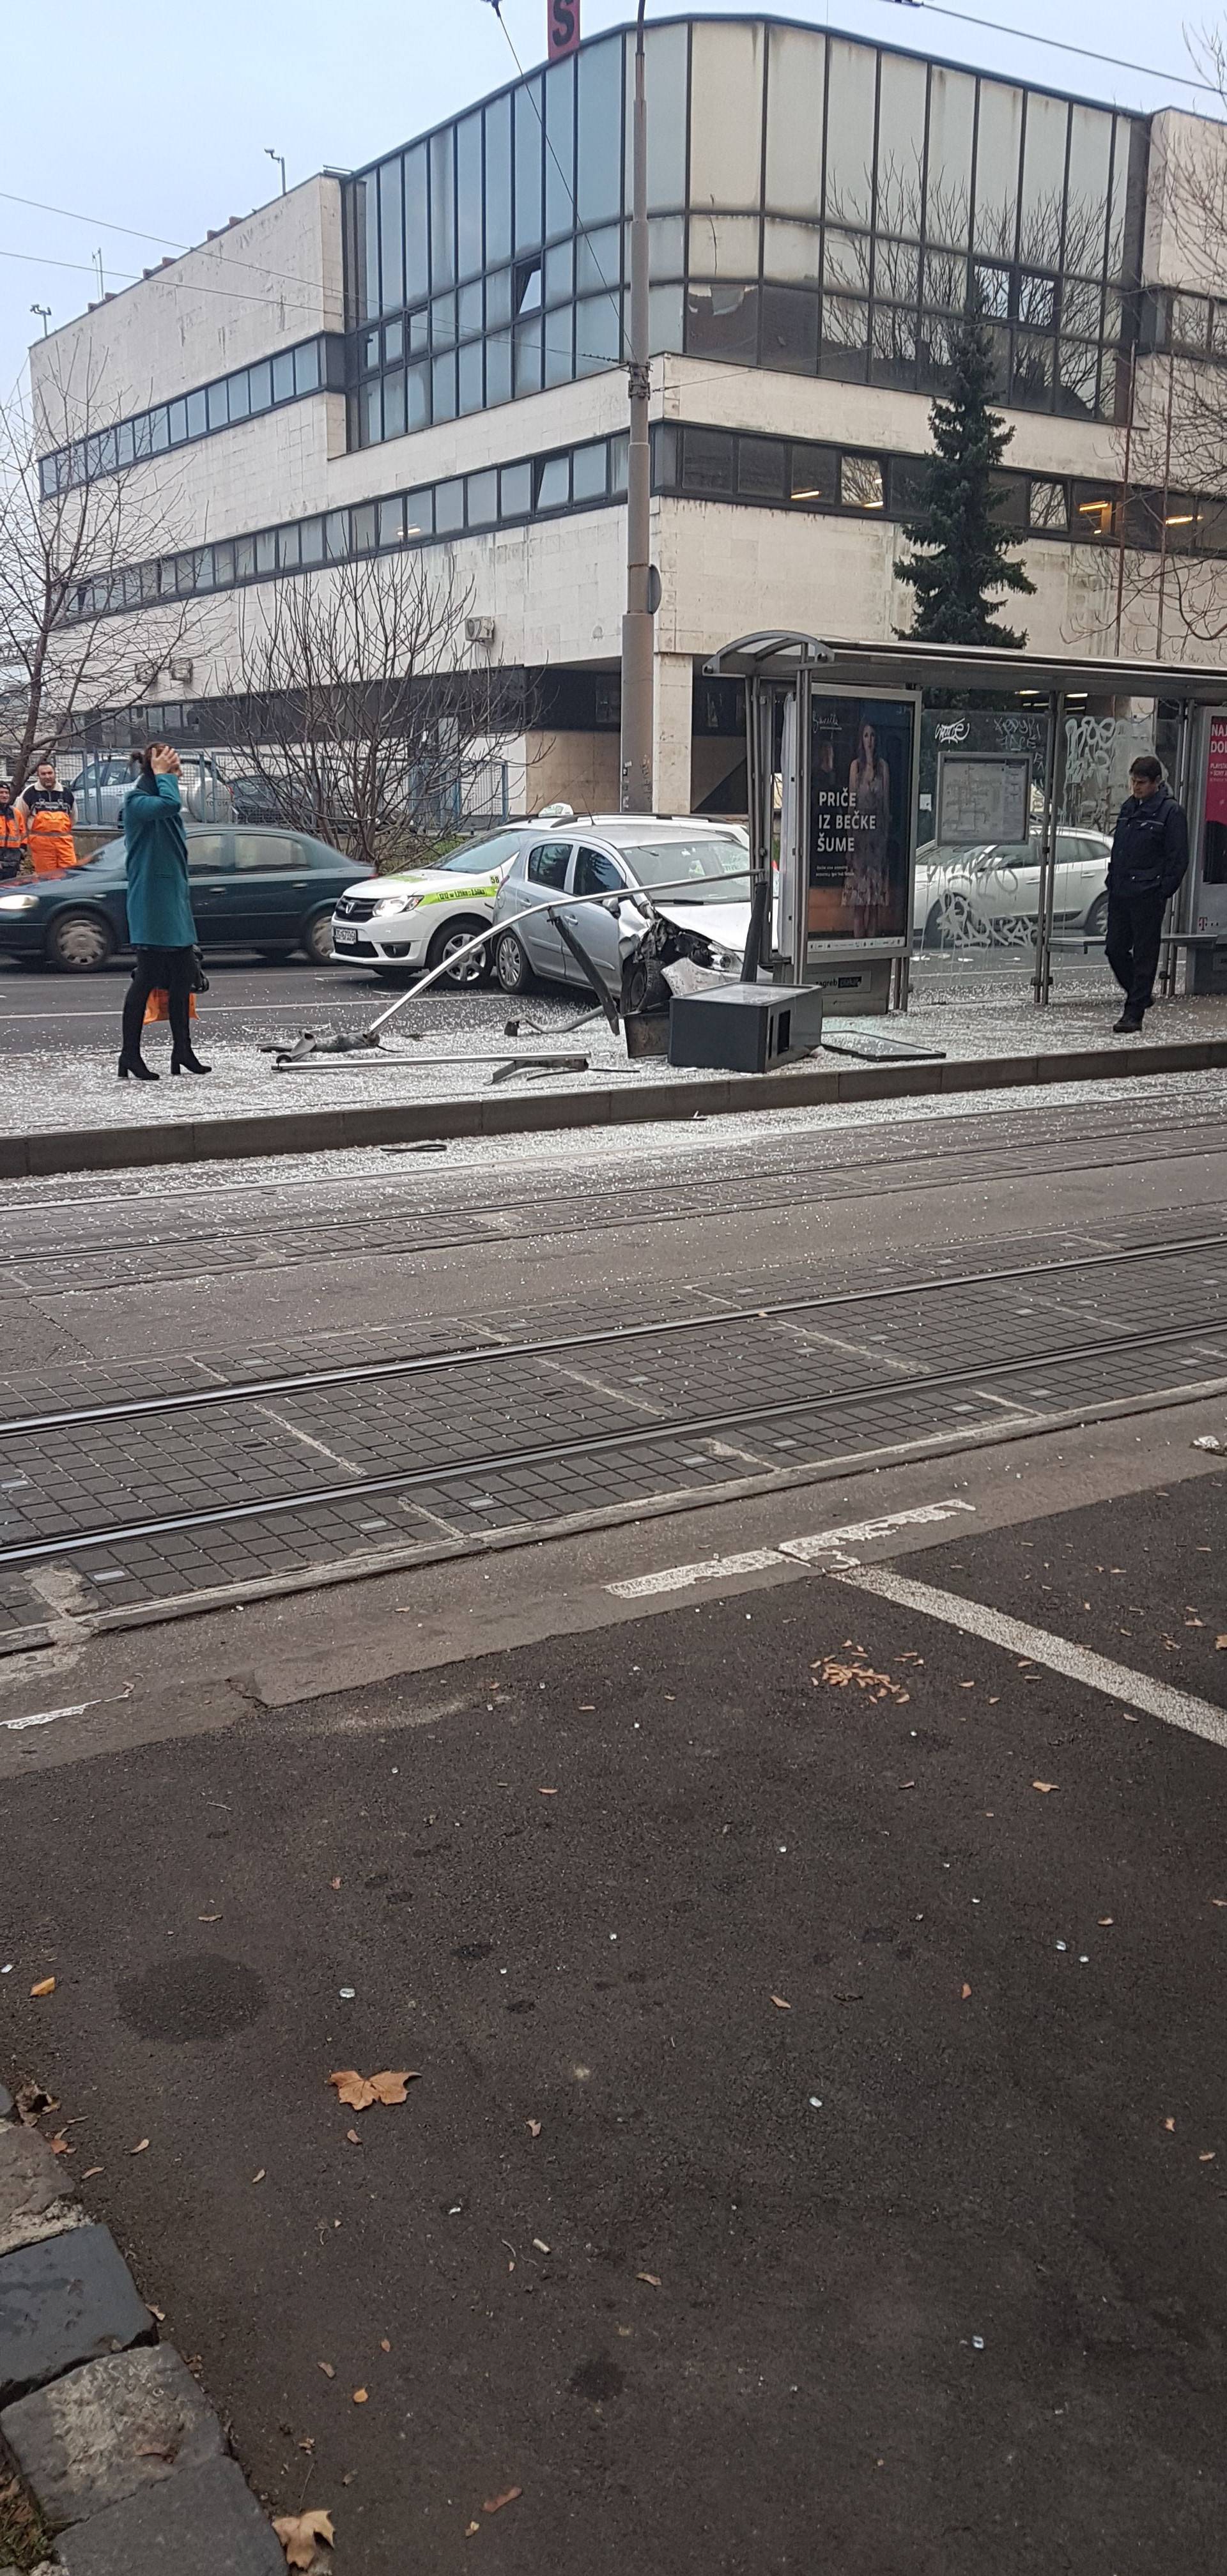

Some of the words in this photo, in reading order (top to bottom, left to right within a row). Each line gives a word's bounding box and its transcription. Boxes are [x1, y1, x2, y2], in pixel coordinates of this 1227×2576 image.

[819, 787, 856, 806] PRIČE
[819, 814, 831, 830] IZ
[835, 809, 876, 830] BEČKE
[817, 831, 855, 852] ŠUME
